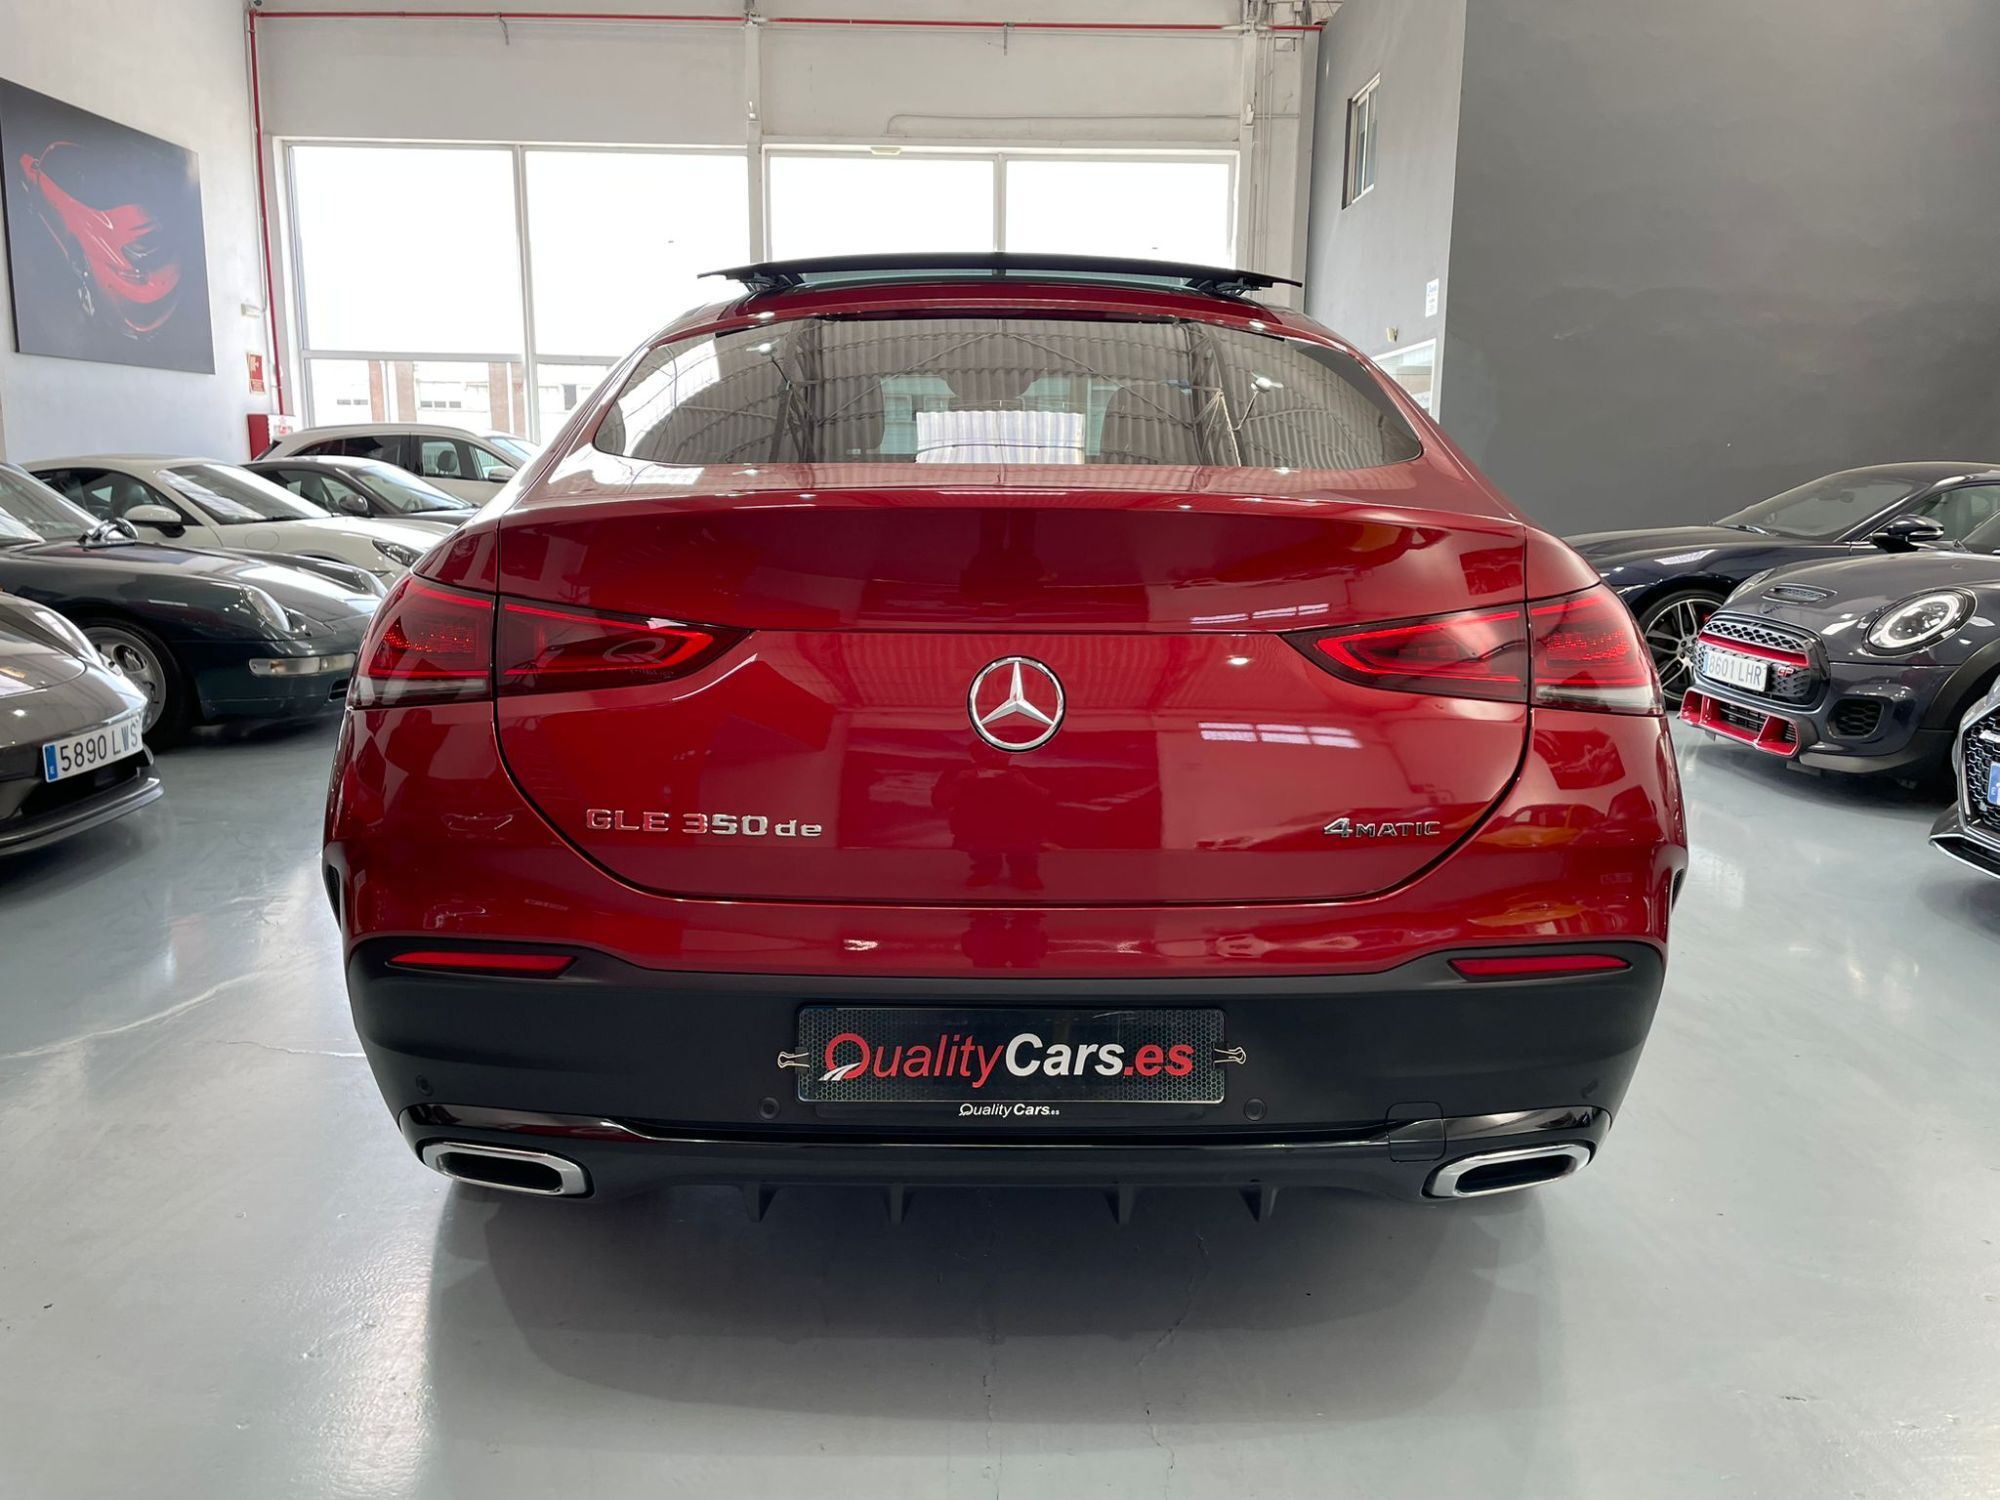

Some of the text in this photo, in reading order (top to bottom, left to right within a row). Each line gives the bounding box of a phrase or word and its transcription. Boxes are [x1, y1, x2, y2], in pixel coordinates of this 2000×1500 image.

[1737, 662, 1762, 686] LHR
[60, 734, 108, 772] 5890
[112, 722, 138, 755] LWS
[586, 808, 670, 832] GLE
[1323, 817, 1441, 838] 4MATIC
